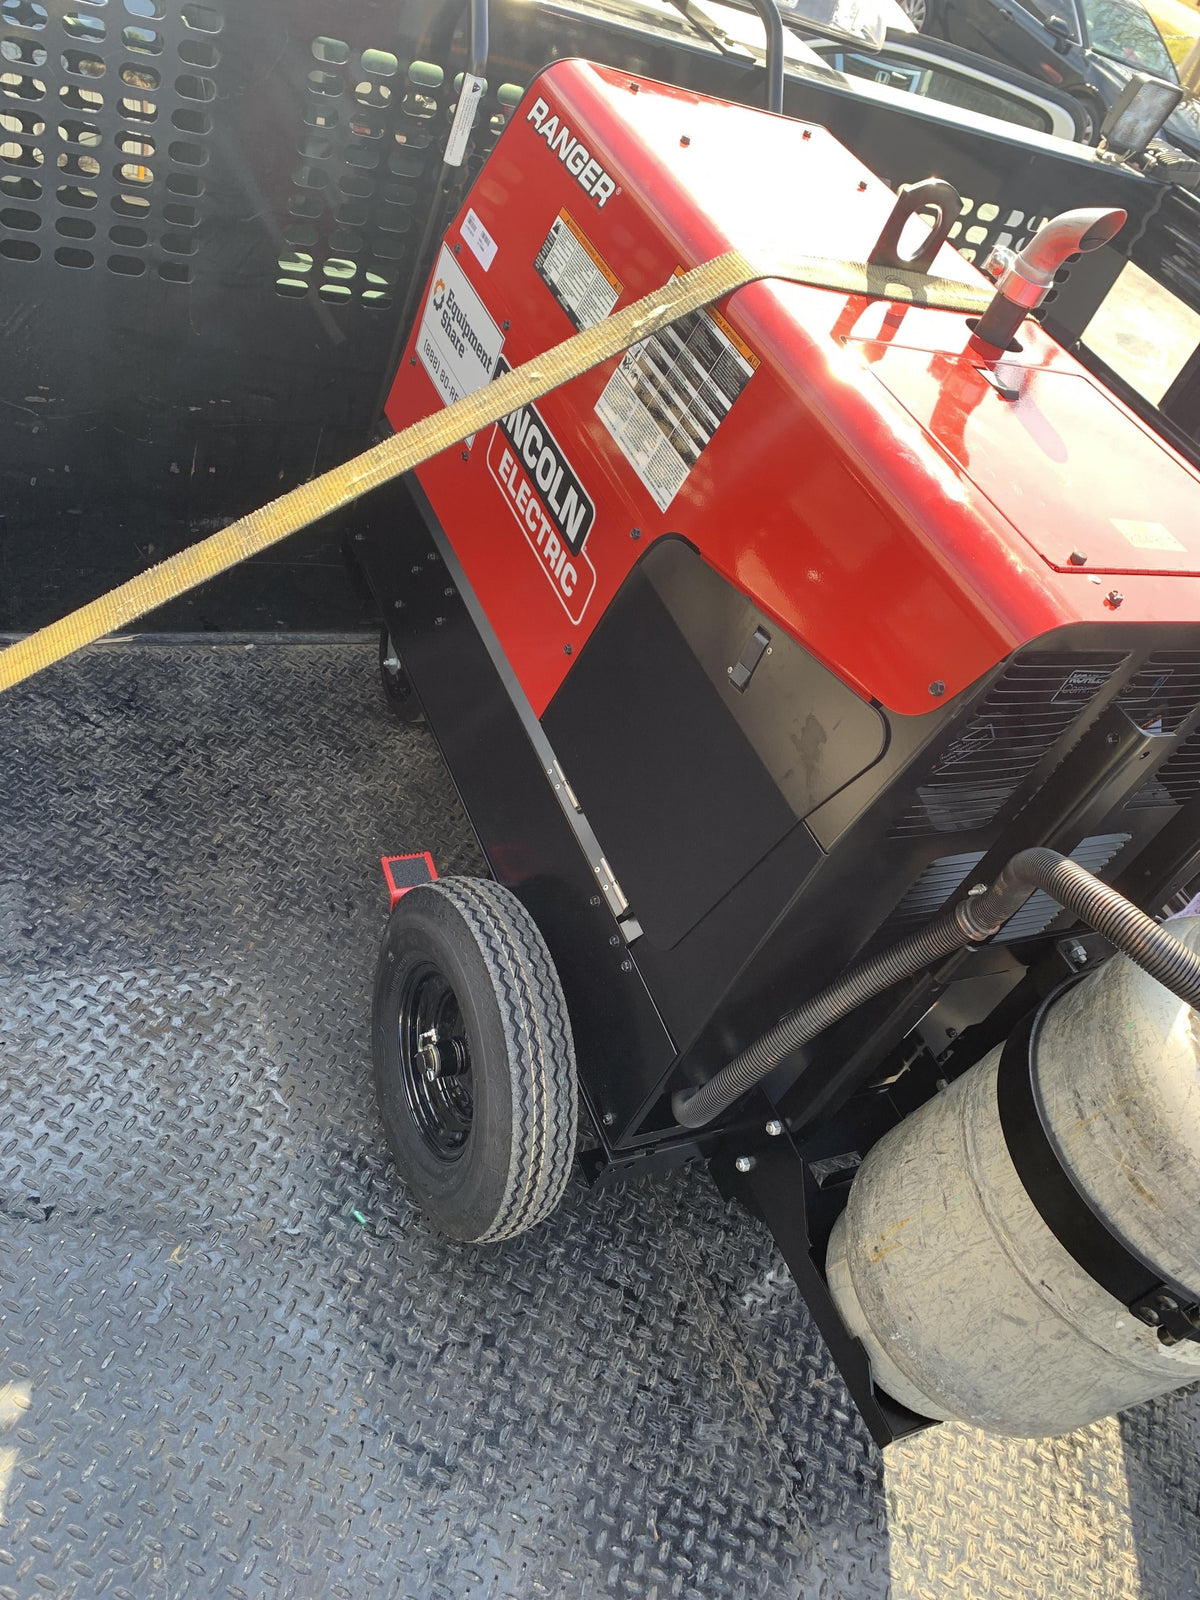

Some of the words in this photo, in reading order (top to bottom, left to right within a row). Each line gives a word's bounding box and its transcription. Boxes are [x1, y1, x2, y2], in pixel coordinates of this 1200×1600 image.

[423, 339, 441, 374] (888)
[439, 369, 460, 404] 80-RE
[440, 310, 466, 359] Share
[446, 288, 494, 374] Equipment
[498, 370, 587, 543] INCOLN
[498, 447, 578, 597] ELECTRIC
